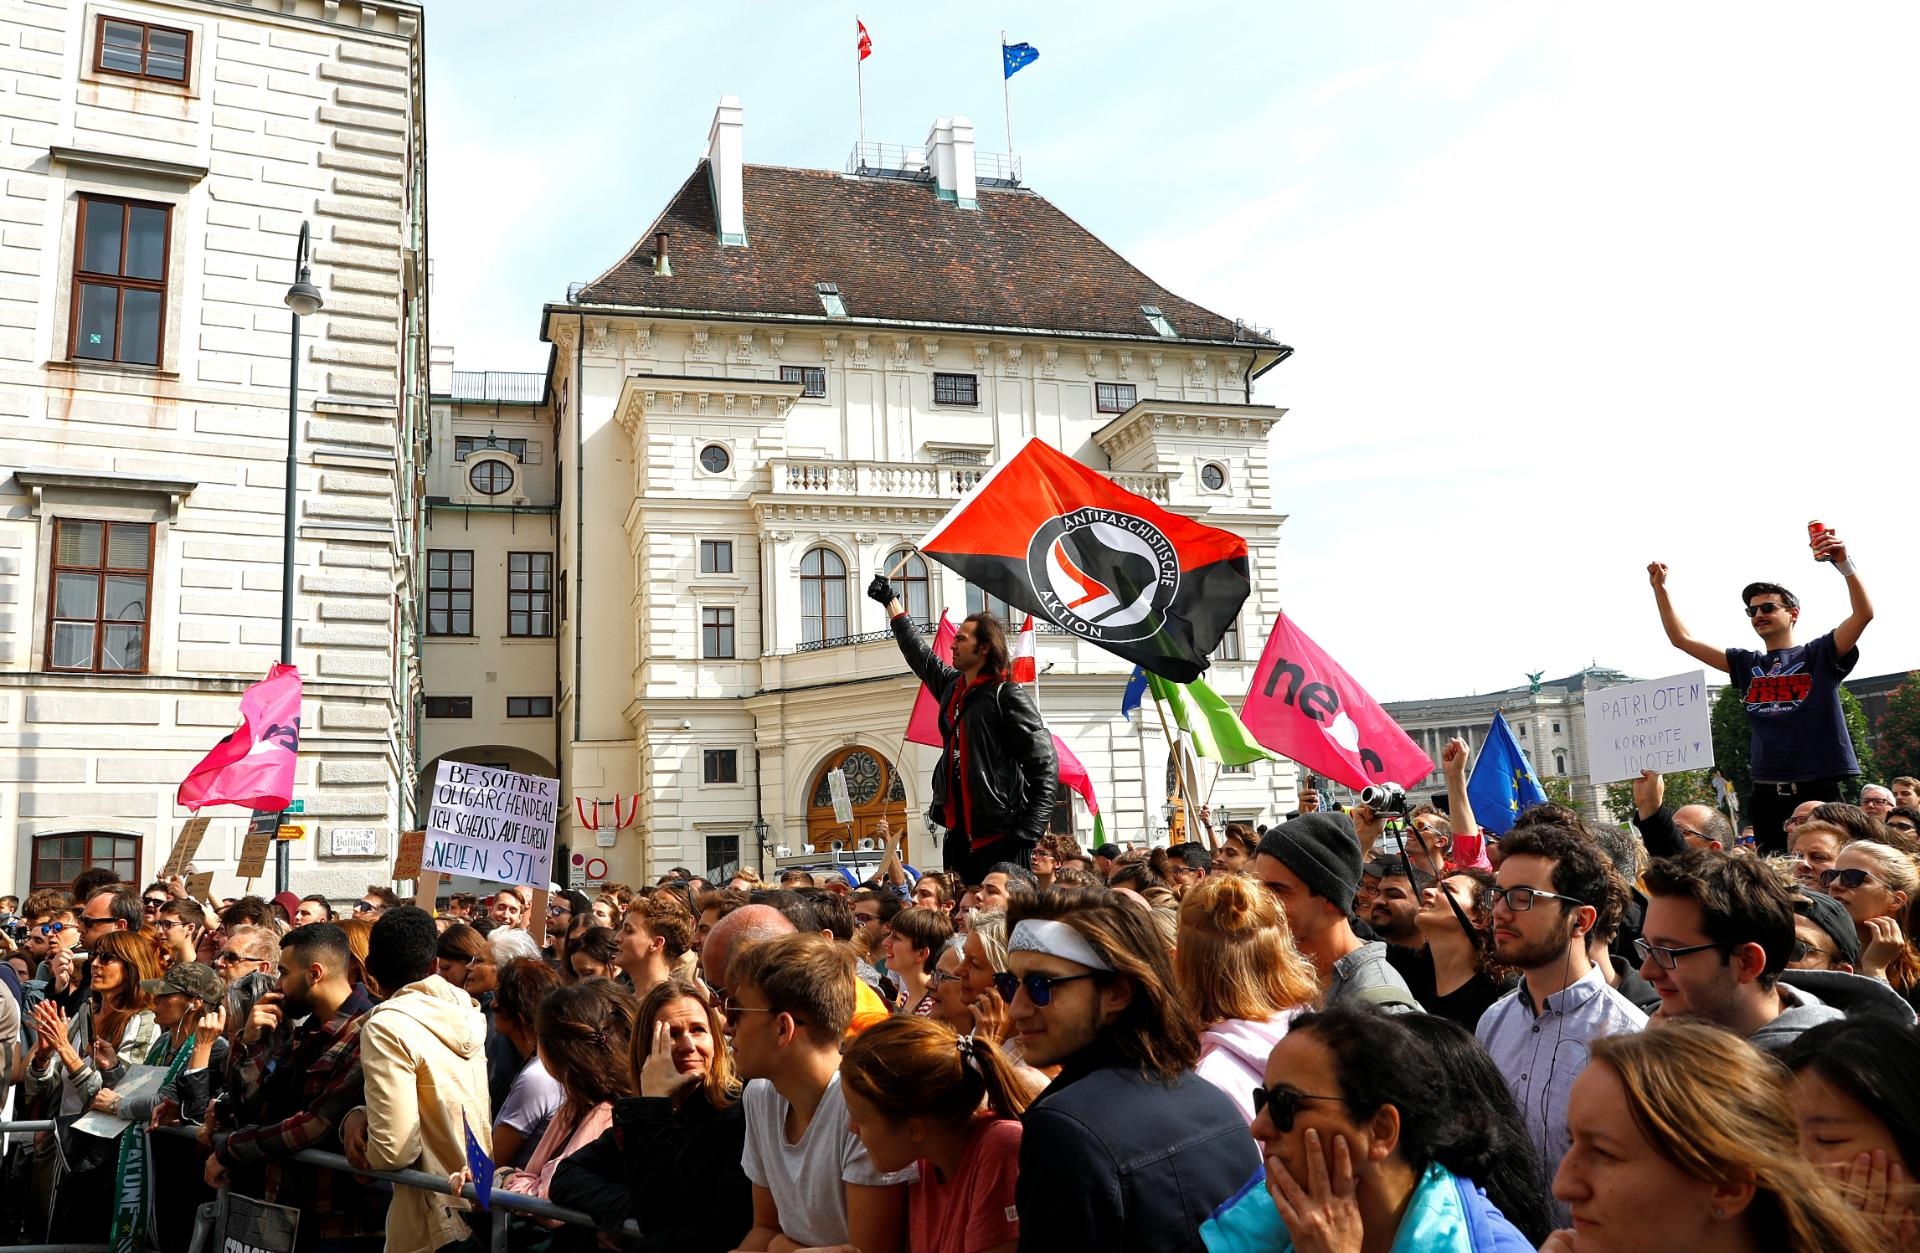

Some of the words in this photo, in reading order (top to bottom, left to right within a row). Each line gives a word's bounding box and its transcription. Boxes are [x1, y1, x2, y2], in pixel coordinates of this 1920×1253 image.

[1063, 509, 1176, 588] ANTIFASCHISTISCHE
[1039, 589, 1102, 638] AKTION
[1602, 684, 1699, 720] PATRIOTEN
[1635, 716, 1658, 726] STATT
[1614, 728, 1682, 751] KORRUPTE
[439, 784, 554, 823] OLIGARCHENDEAL
[432, 809, 451, 831] ICH
[496, 820, 521, 843] AUF
[521, 825, 549, 850] EUREN
[118, 1148, 143, 1216] ALONE
